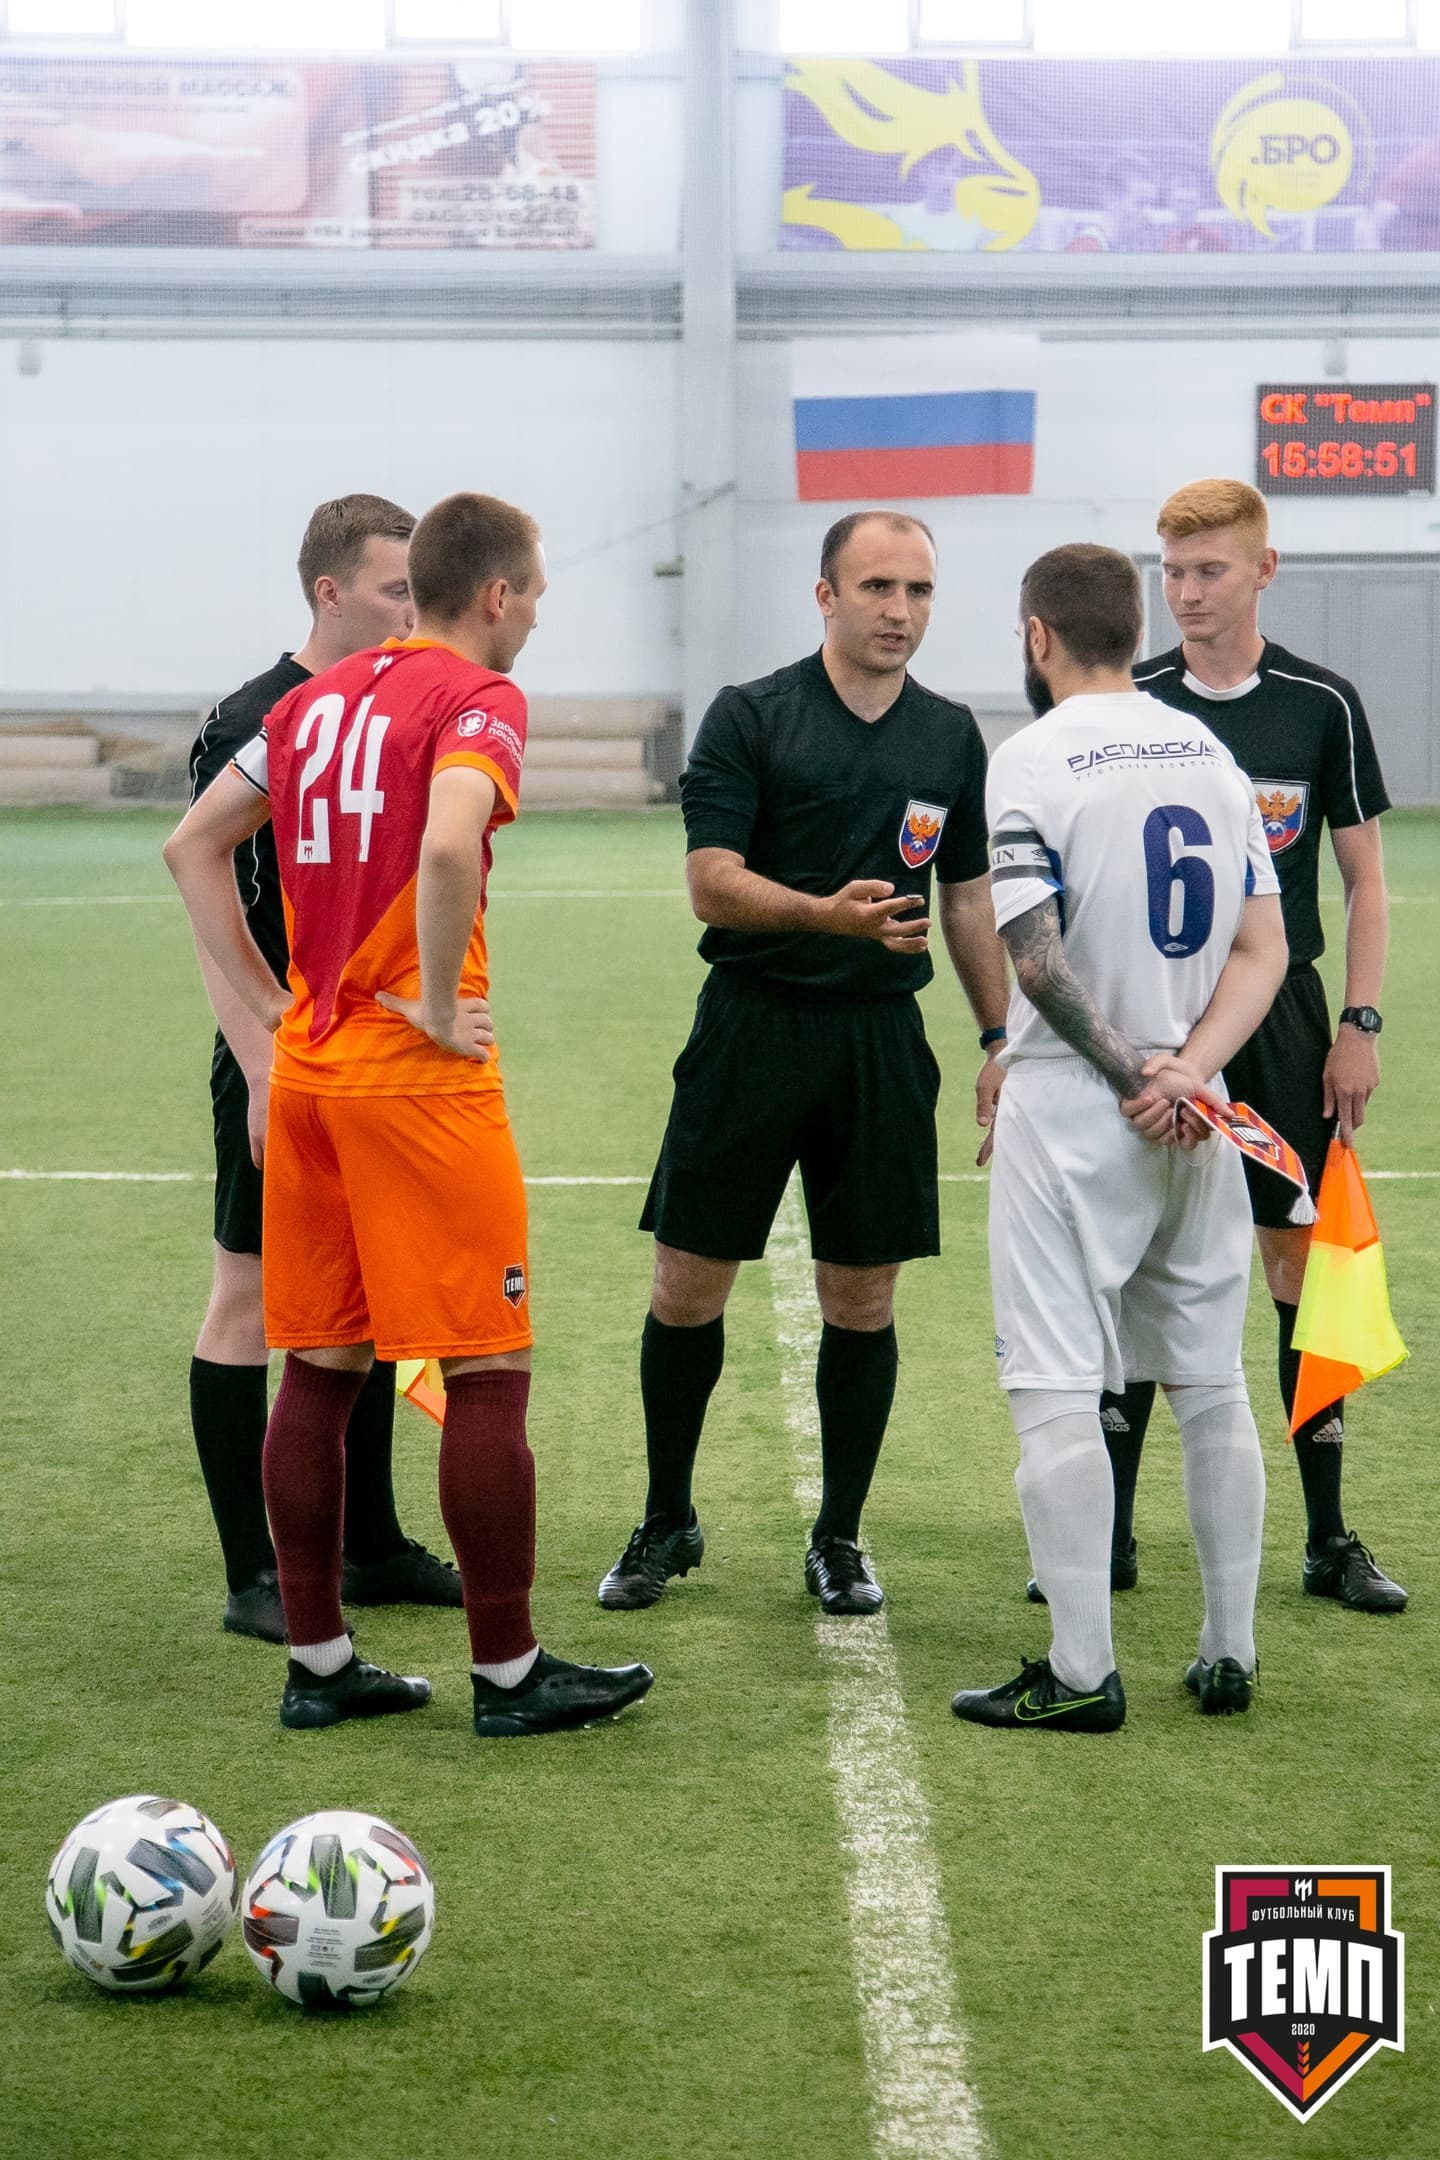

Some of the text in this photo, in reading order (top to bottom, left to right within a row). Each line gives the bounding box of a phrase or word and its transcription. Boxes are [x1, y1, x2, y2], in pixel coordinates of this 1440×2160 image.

[1260, 393, 1308, 424] СК
[1262, 441, 1417, 478] 15:58:51
[1067, 740, 1221, 773] РАСПАДСКА
[295, 693, 392, 864] 24
[1143, 804, 1215, 959] 6
